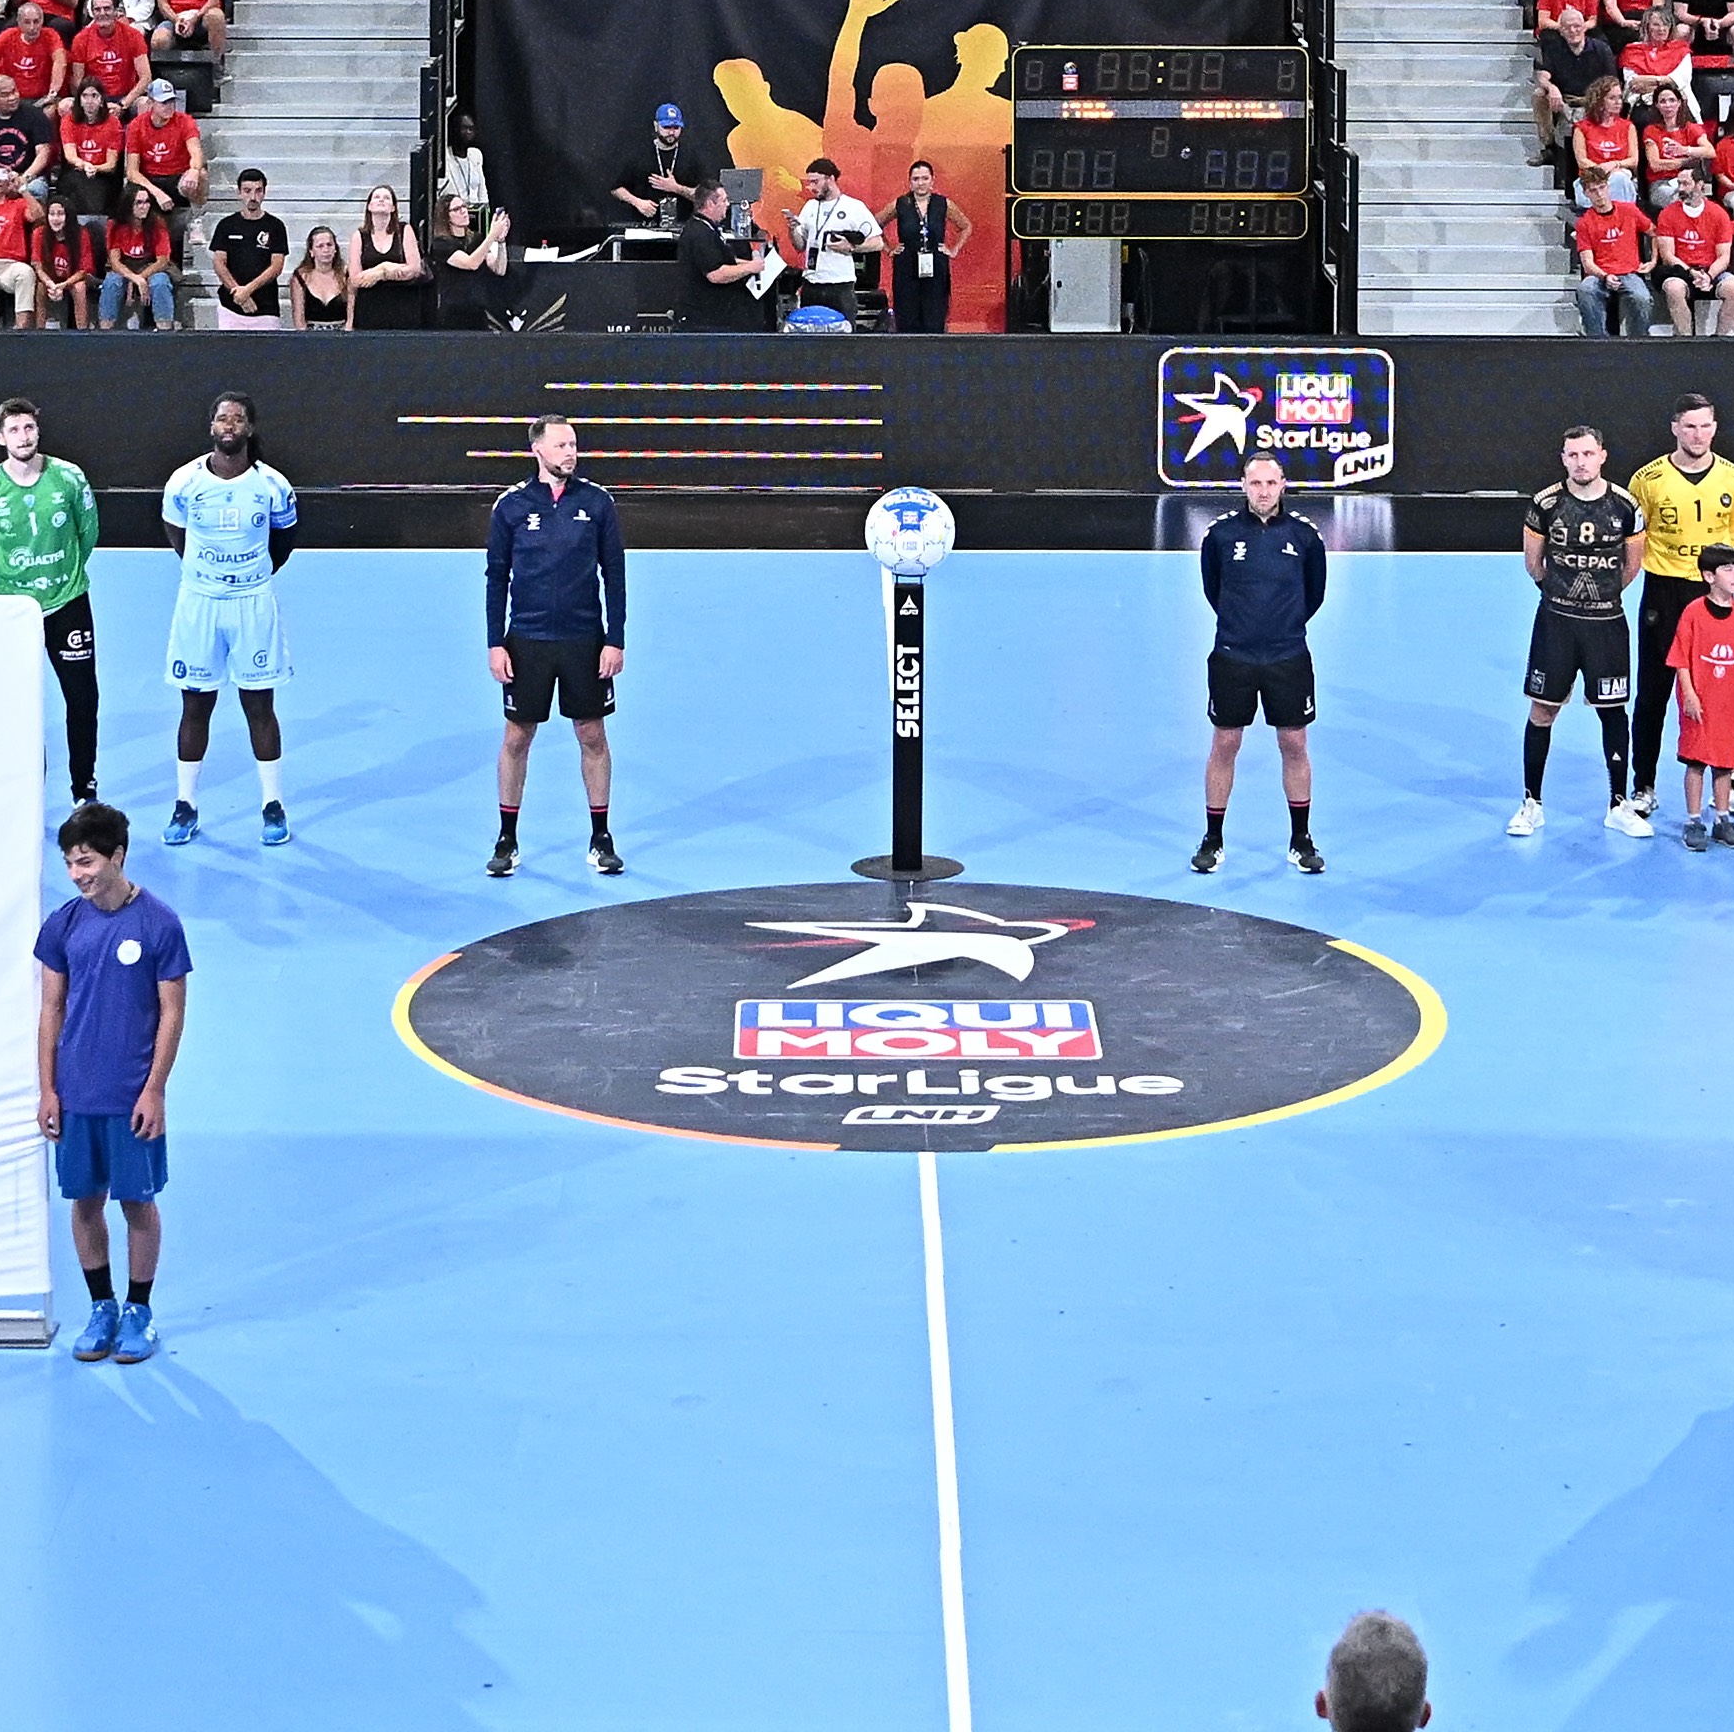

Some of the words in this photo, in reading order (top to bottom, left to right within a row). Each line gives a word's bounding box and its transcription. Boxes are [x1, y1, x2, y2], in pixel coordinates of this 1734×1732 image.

[1281, 375, 1349, 398] LIQUI
[1281, 398, 1350, 421] MOLY
[1256, 424, 1372, 452] StarLigue
[218, 508, 240, 531] 13
[1693, 499, 1702, 522] 1
[28, 511, 38, 537] 1
[1580, 521, 1595, 544] 8
[1565, 555, 1618, 569] CEPAC
[896, 644, 920, 738] SELECT
[758, 1003, 1074, 1030] LIQUI
[756, 1030, 1087, 1056] MOLY
[655, 1066, 1185, 1102] StarLigue
